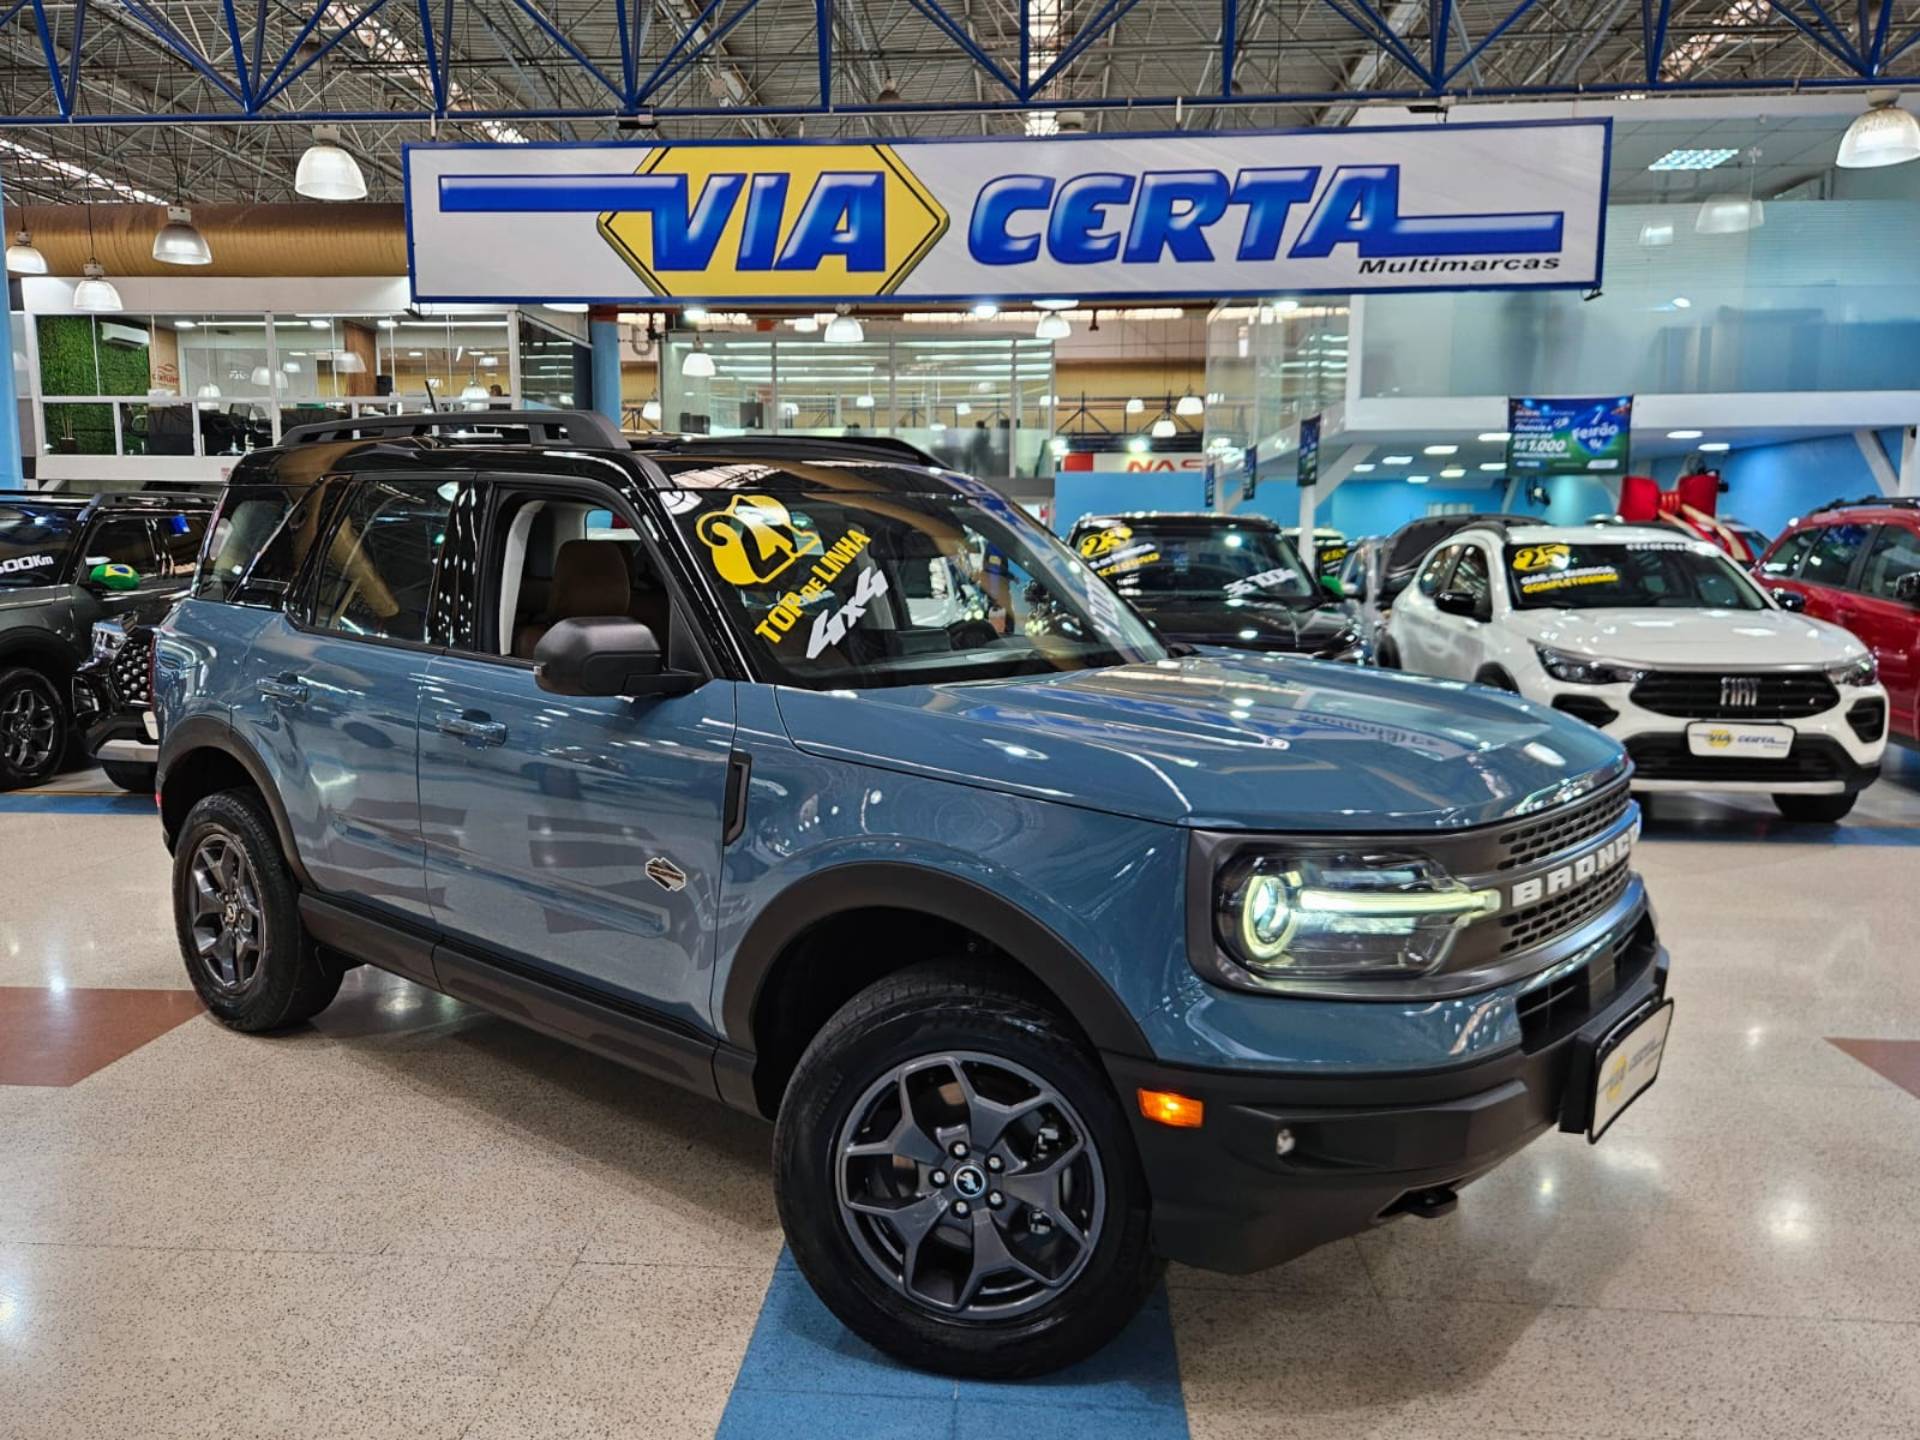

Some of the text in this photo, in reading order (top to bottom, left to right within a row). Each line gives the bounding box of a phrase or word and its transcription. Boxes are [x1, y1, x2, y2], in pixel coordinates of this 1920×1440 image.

[650, 165, 1399, 272] VIA CERTA
[1359, 256, 1561, 275] Multimarcas
[754, 529, 872, 644] TOP DE LINHA
[1512, 543, 1570, 572] 25
[806, 566, 889, 659] 4x4
[1720, 676, 1761, 706] FIAT
